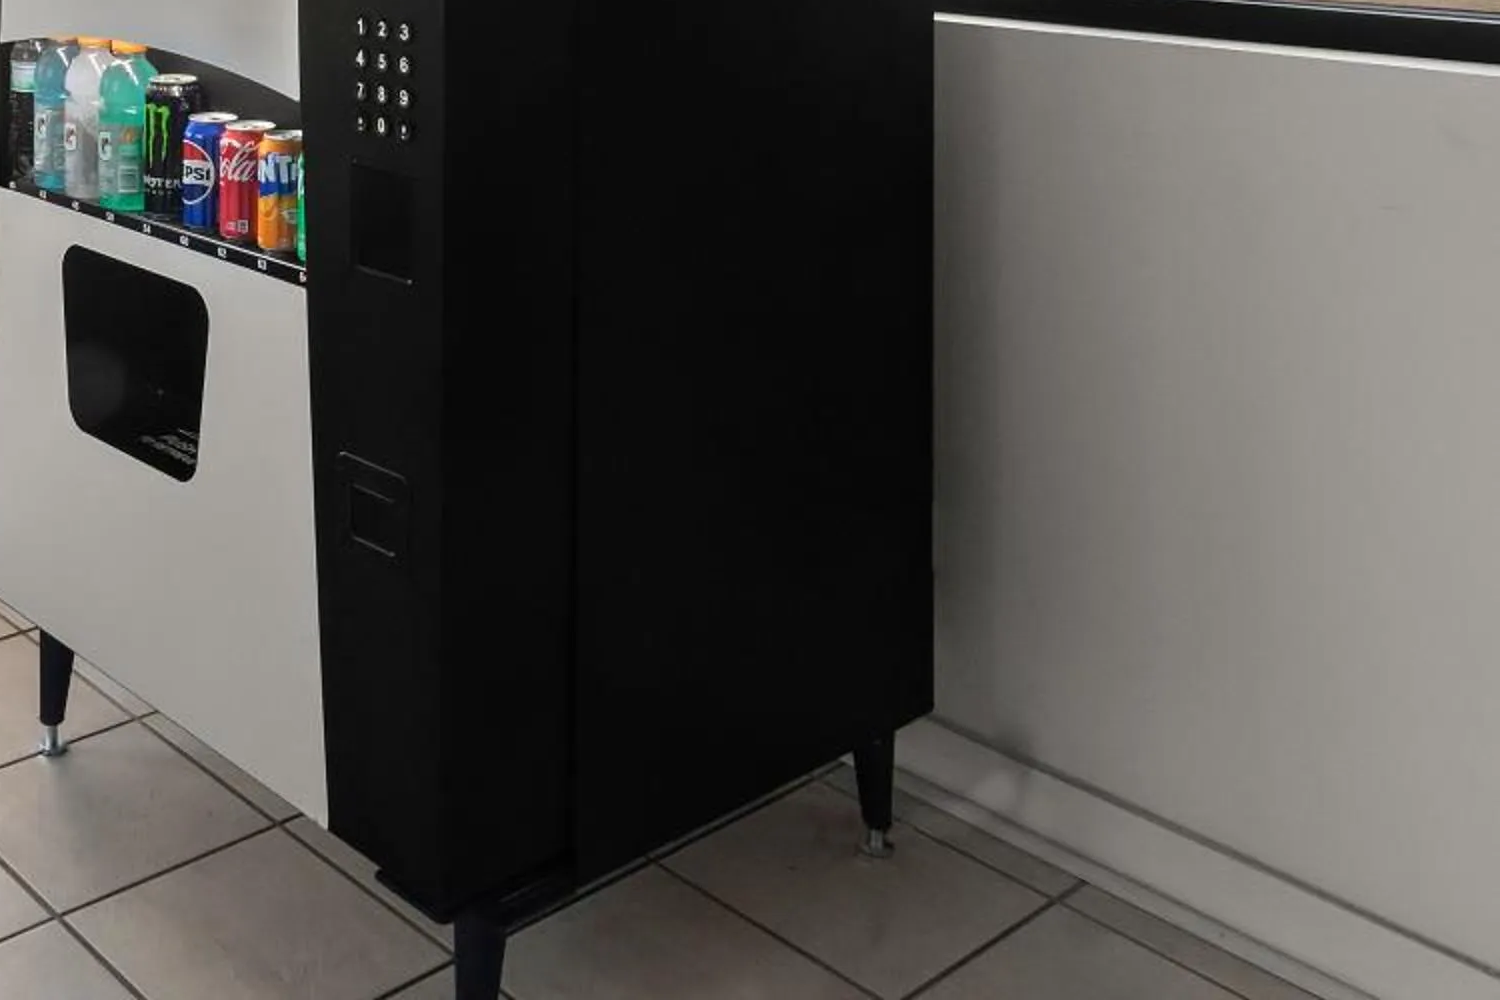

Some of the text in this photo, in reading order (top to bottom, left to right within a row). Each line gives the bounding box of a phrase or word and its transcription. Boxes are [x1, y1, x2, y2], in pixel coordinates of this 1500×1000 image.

[378, 20, 387, 38] 2
[399, 23, 409, 41] 3
[356, 49, 409, 73] 4 5 6
[357, 82, 409, 105] 7 8 9
[377, 117, 386, 134] 0
[185, 165, 211, 181] PSI
